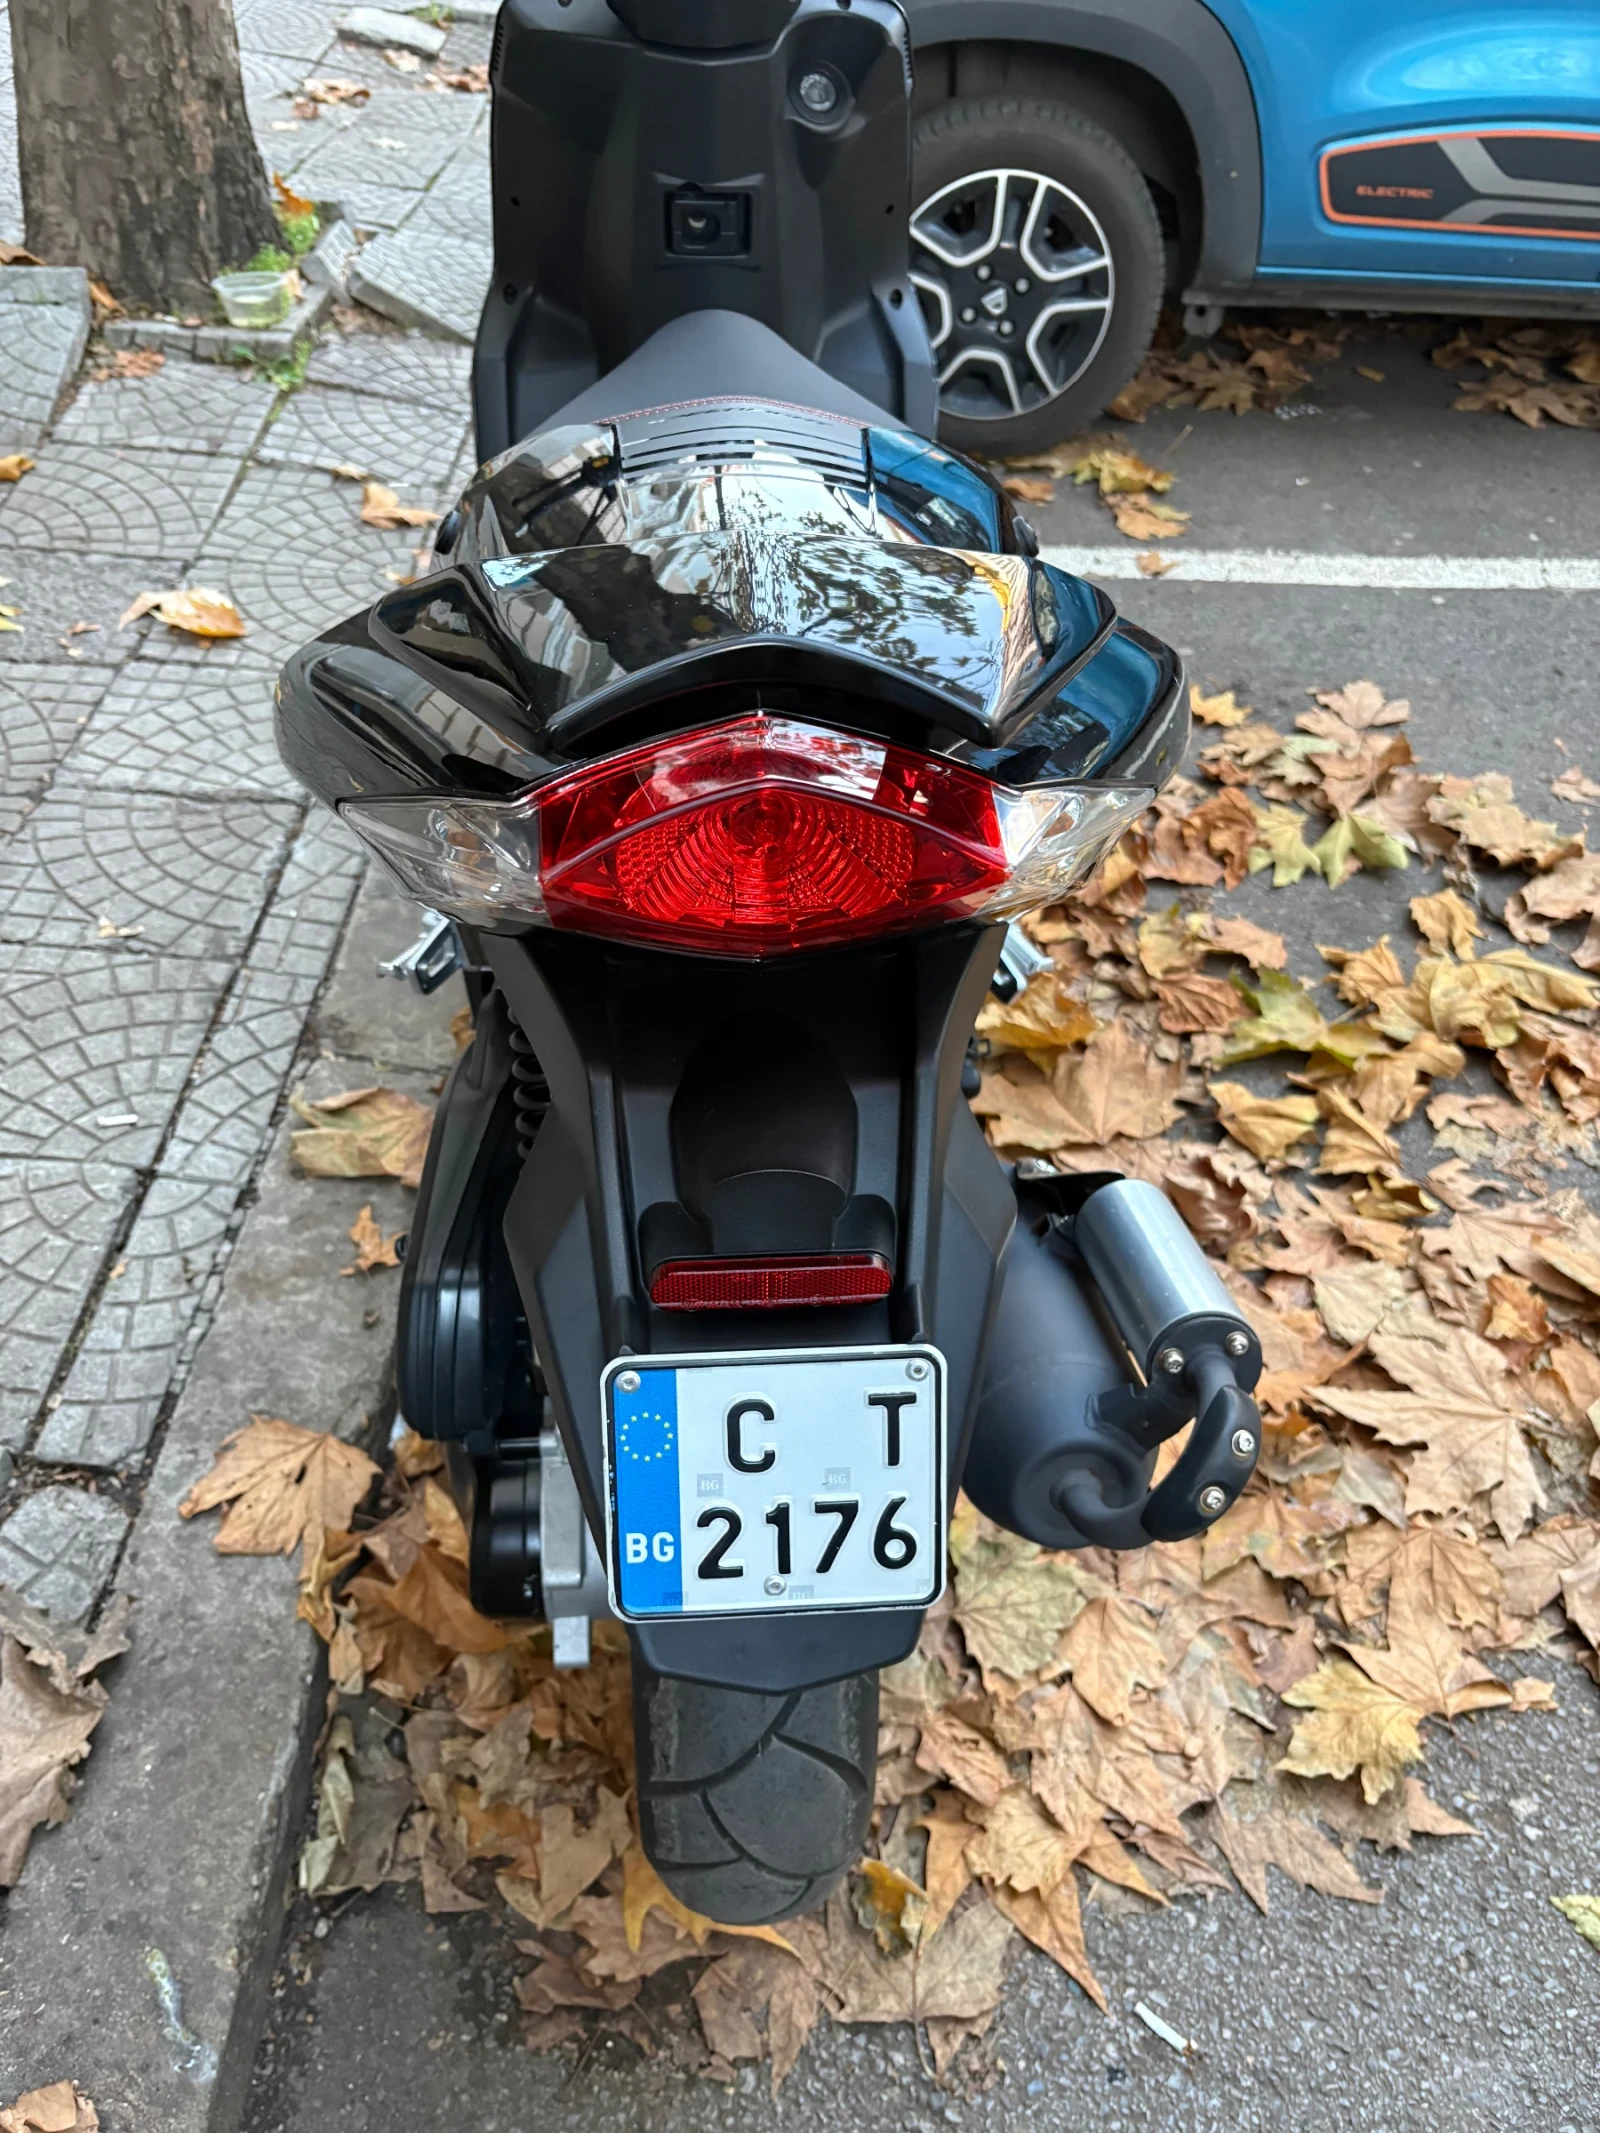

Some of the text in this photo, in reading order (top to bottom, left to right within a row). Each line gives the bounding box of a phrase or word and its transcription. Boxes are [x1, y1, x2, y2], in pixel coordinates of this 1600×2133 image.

[1356, 185, 1433, 199] ELECTRIC
[727, 1391, 917, 1473] C T
[625, 1532, 675, 1564] BG
[697, 1496, 917, 1579] 2176
